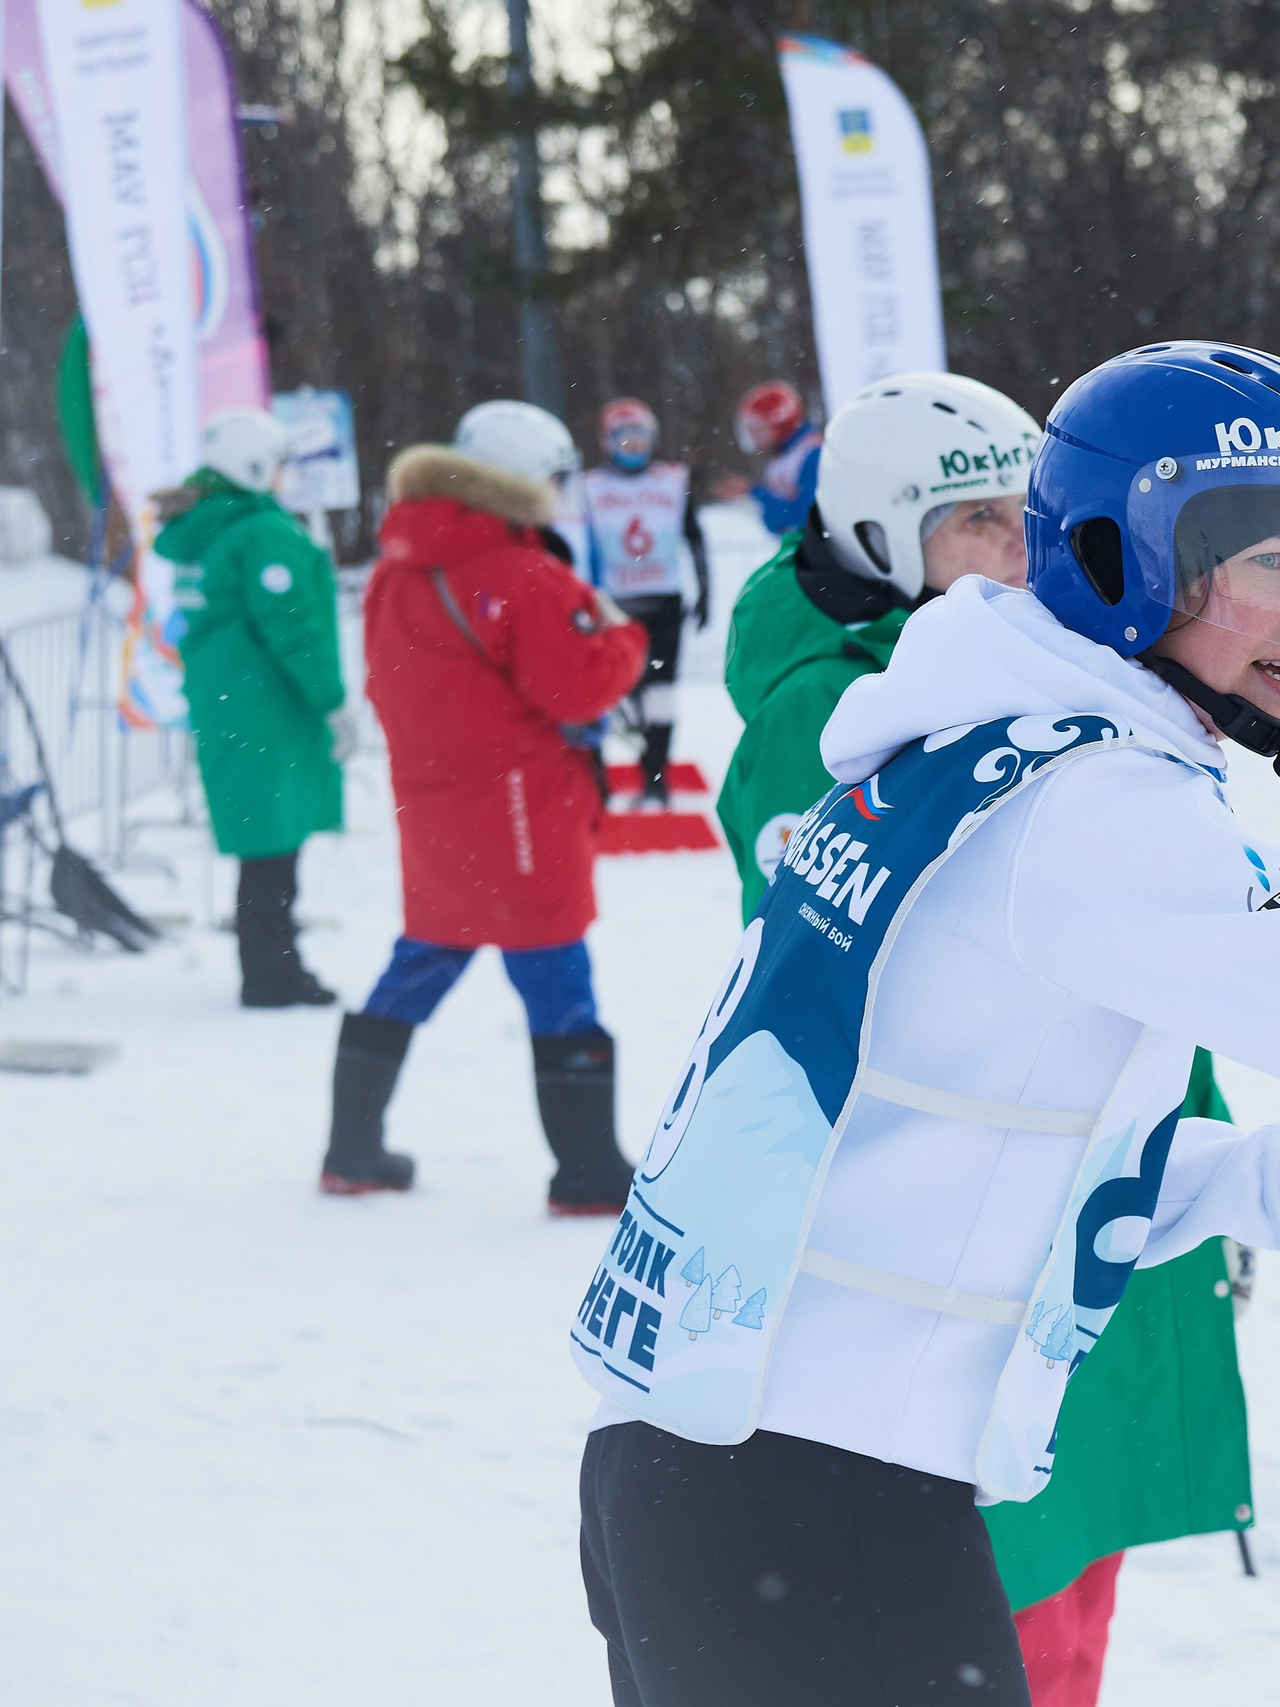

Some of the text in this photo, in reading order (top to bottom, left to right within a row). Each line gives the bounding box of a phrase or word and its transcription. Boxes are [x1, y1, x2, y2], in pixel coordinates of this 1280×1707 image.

[624, 515, 654, 557] 6
[798, 902, 853, 953] СНЕЖНЫЙ БОЙ
[611, 1208, 677, 1299] ТОЛК
